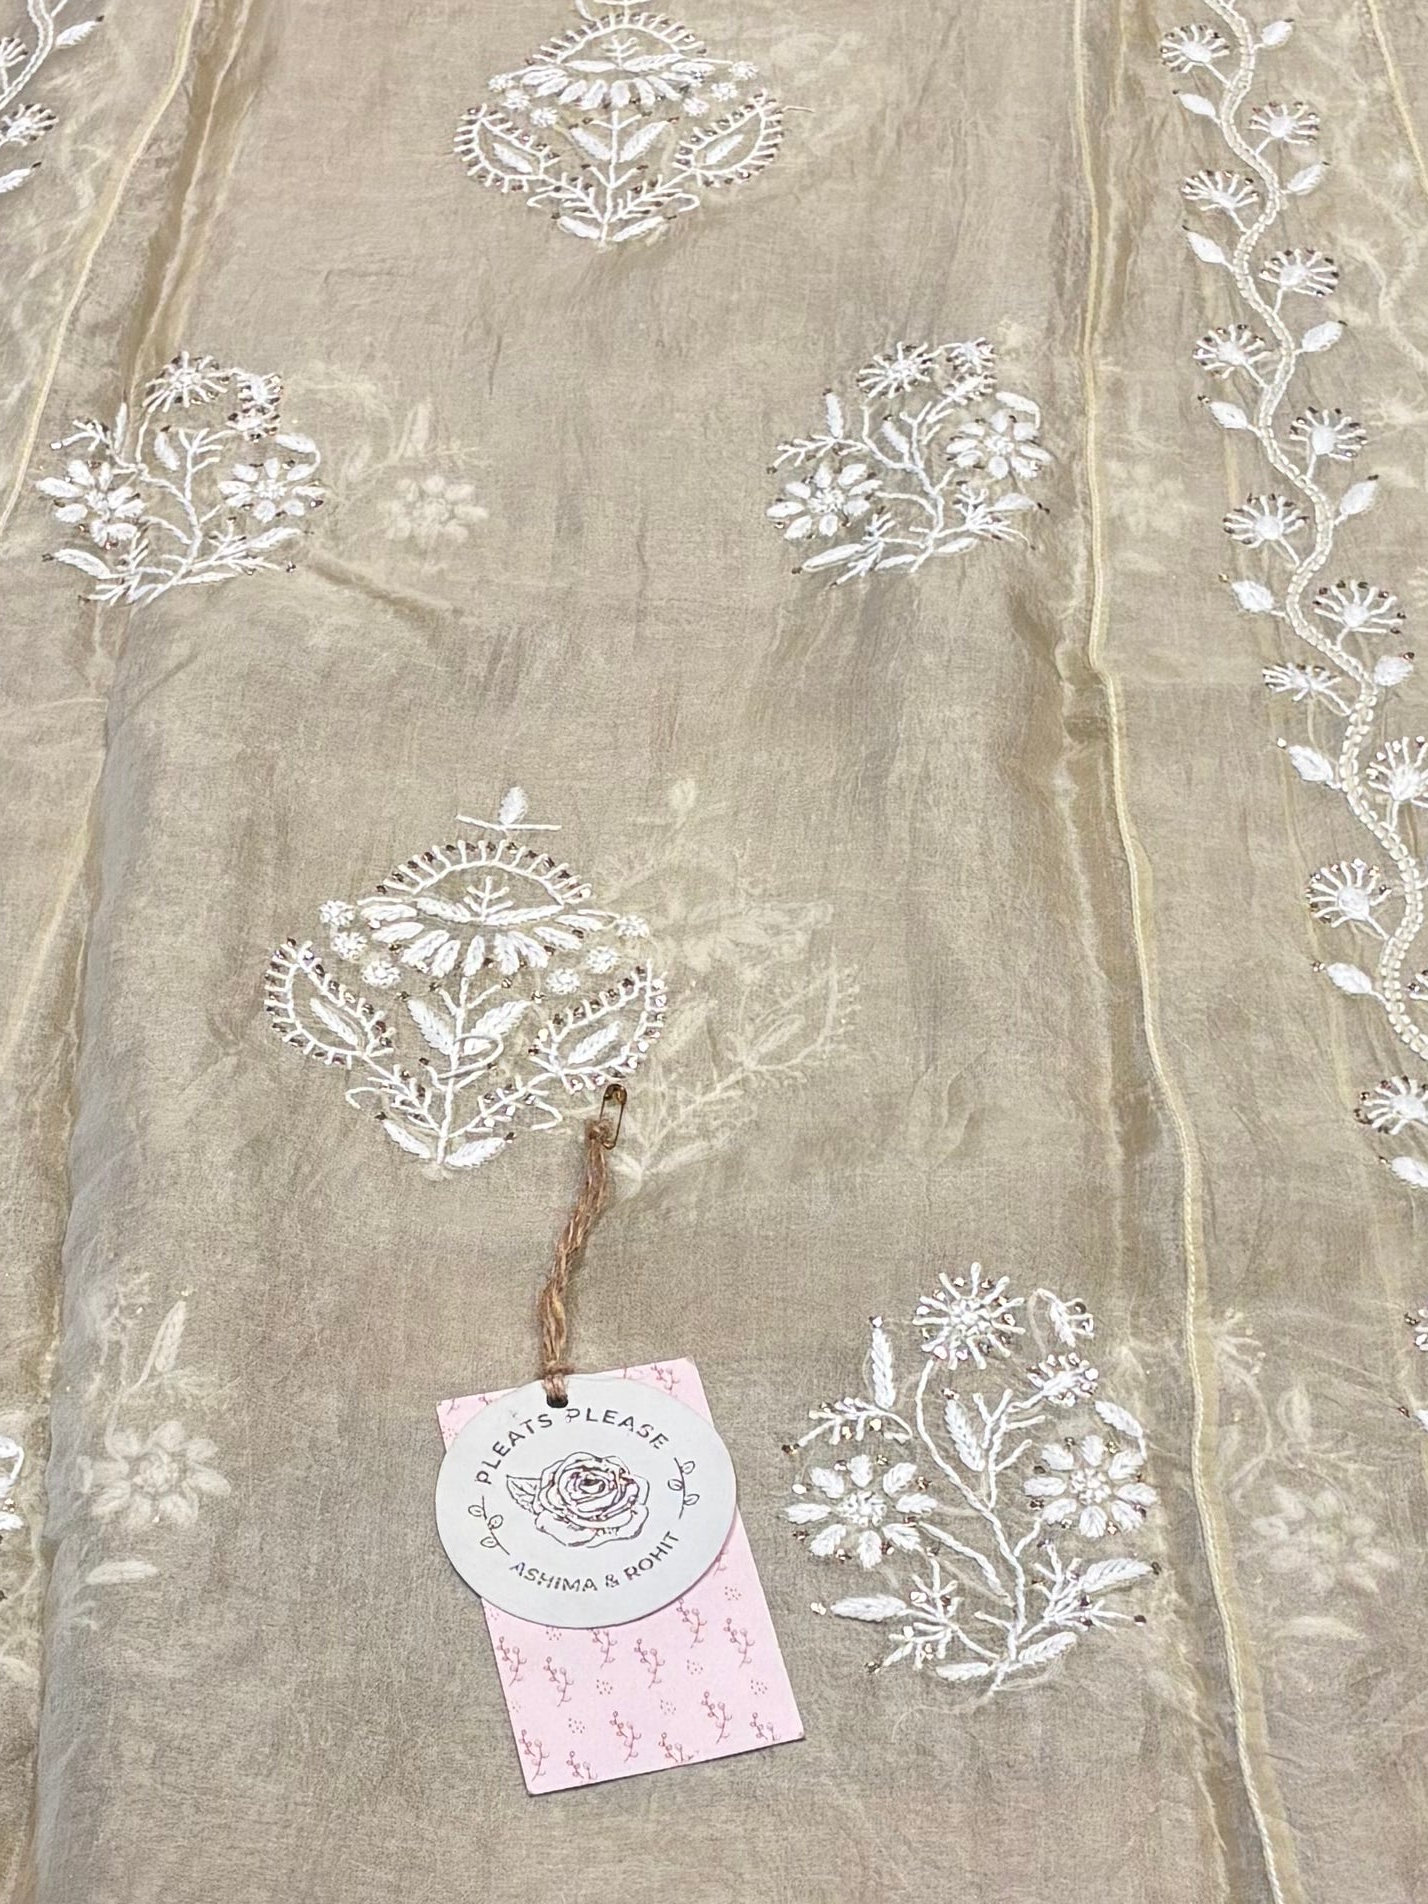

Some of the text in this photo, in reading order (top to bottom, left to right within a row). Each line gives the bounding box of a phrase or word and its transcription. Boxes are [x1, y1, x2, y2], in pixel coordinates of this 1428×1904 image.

[476, 1407, 670, 1485] PLEATS PLEASE
[509, 1530, 680, 1592] ASHIMA & ROHIT
